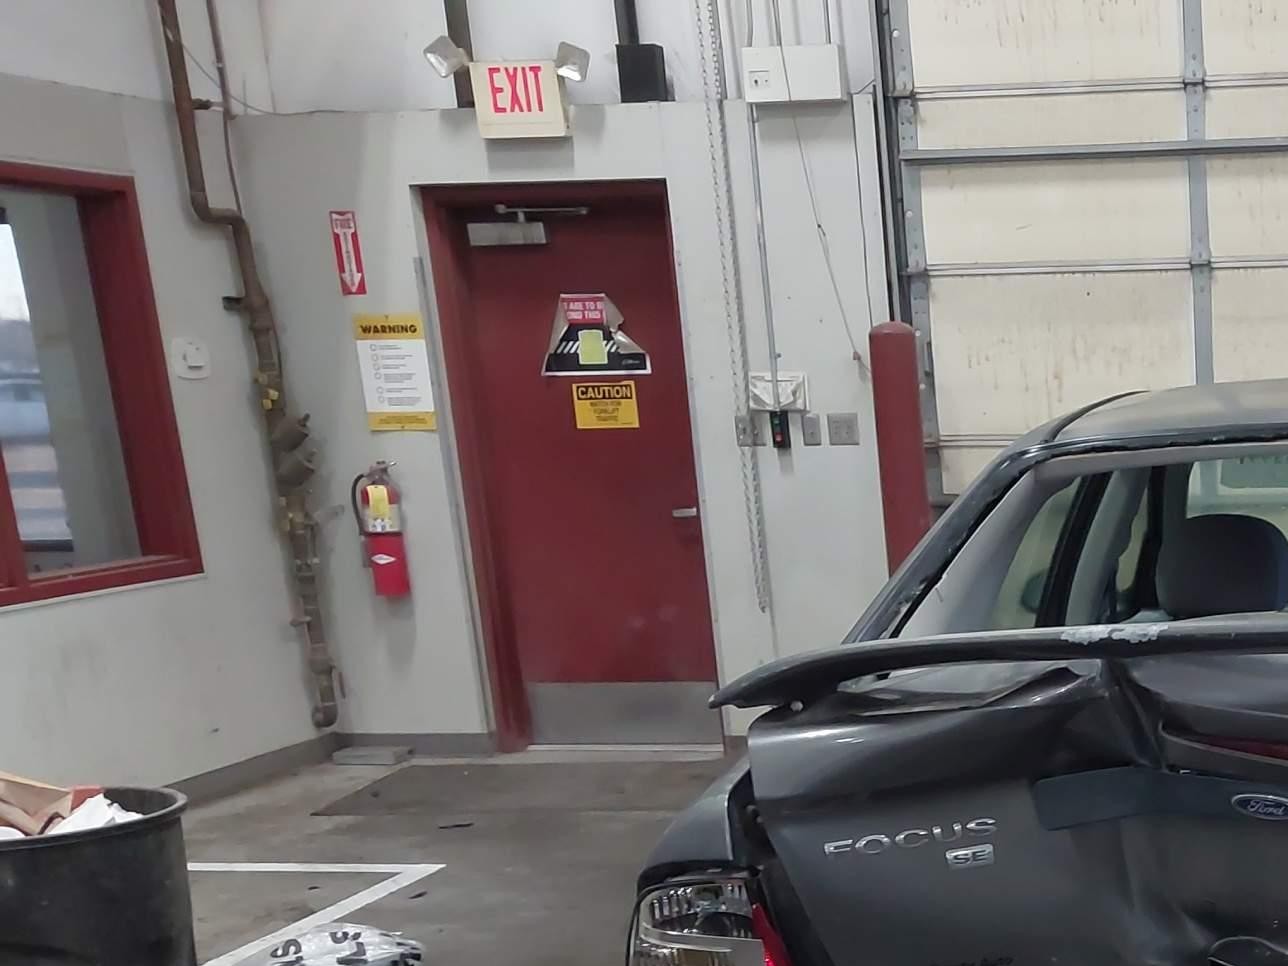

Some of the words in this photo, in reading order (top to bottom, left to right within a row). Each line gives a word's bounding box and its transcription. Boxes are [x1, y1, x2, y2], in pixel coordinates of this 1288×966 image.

[487, 65, 544, 113] EXIT
[359, 324, 417, 334] WARNING
[578, 386, 631, 399] CAUTION
[824, 818, 997, 855] FOCUS
